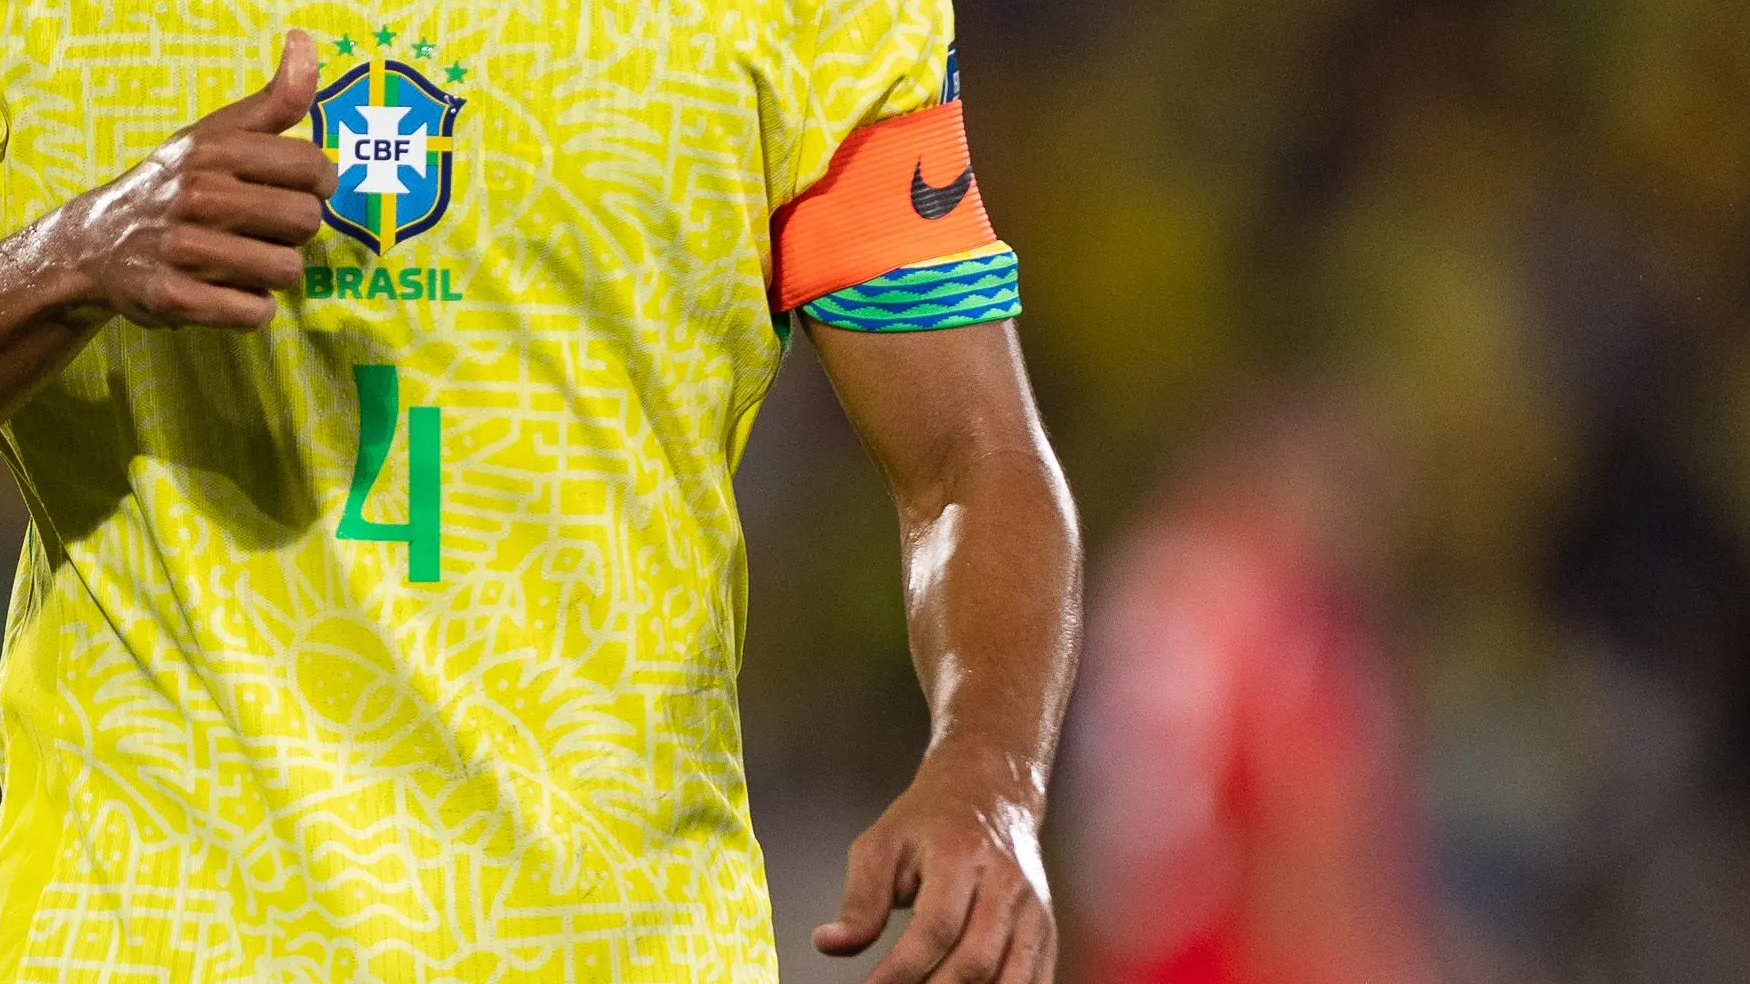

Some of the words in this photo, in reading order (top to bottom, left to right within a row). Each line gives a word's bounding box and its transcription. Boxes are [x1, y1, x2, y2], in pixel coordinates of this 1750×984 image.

[355, 139, 410, 161] CBF
[305, 266, 463, 301] BRASIL
[335, 363, 441, 583] 4
